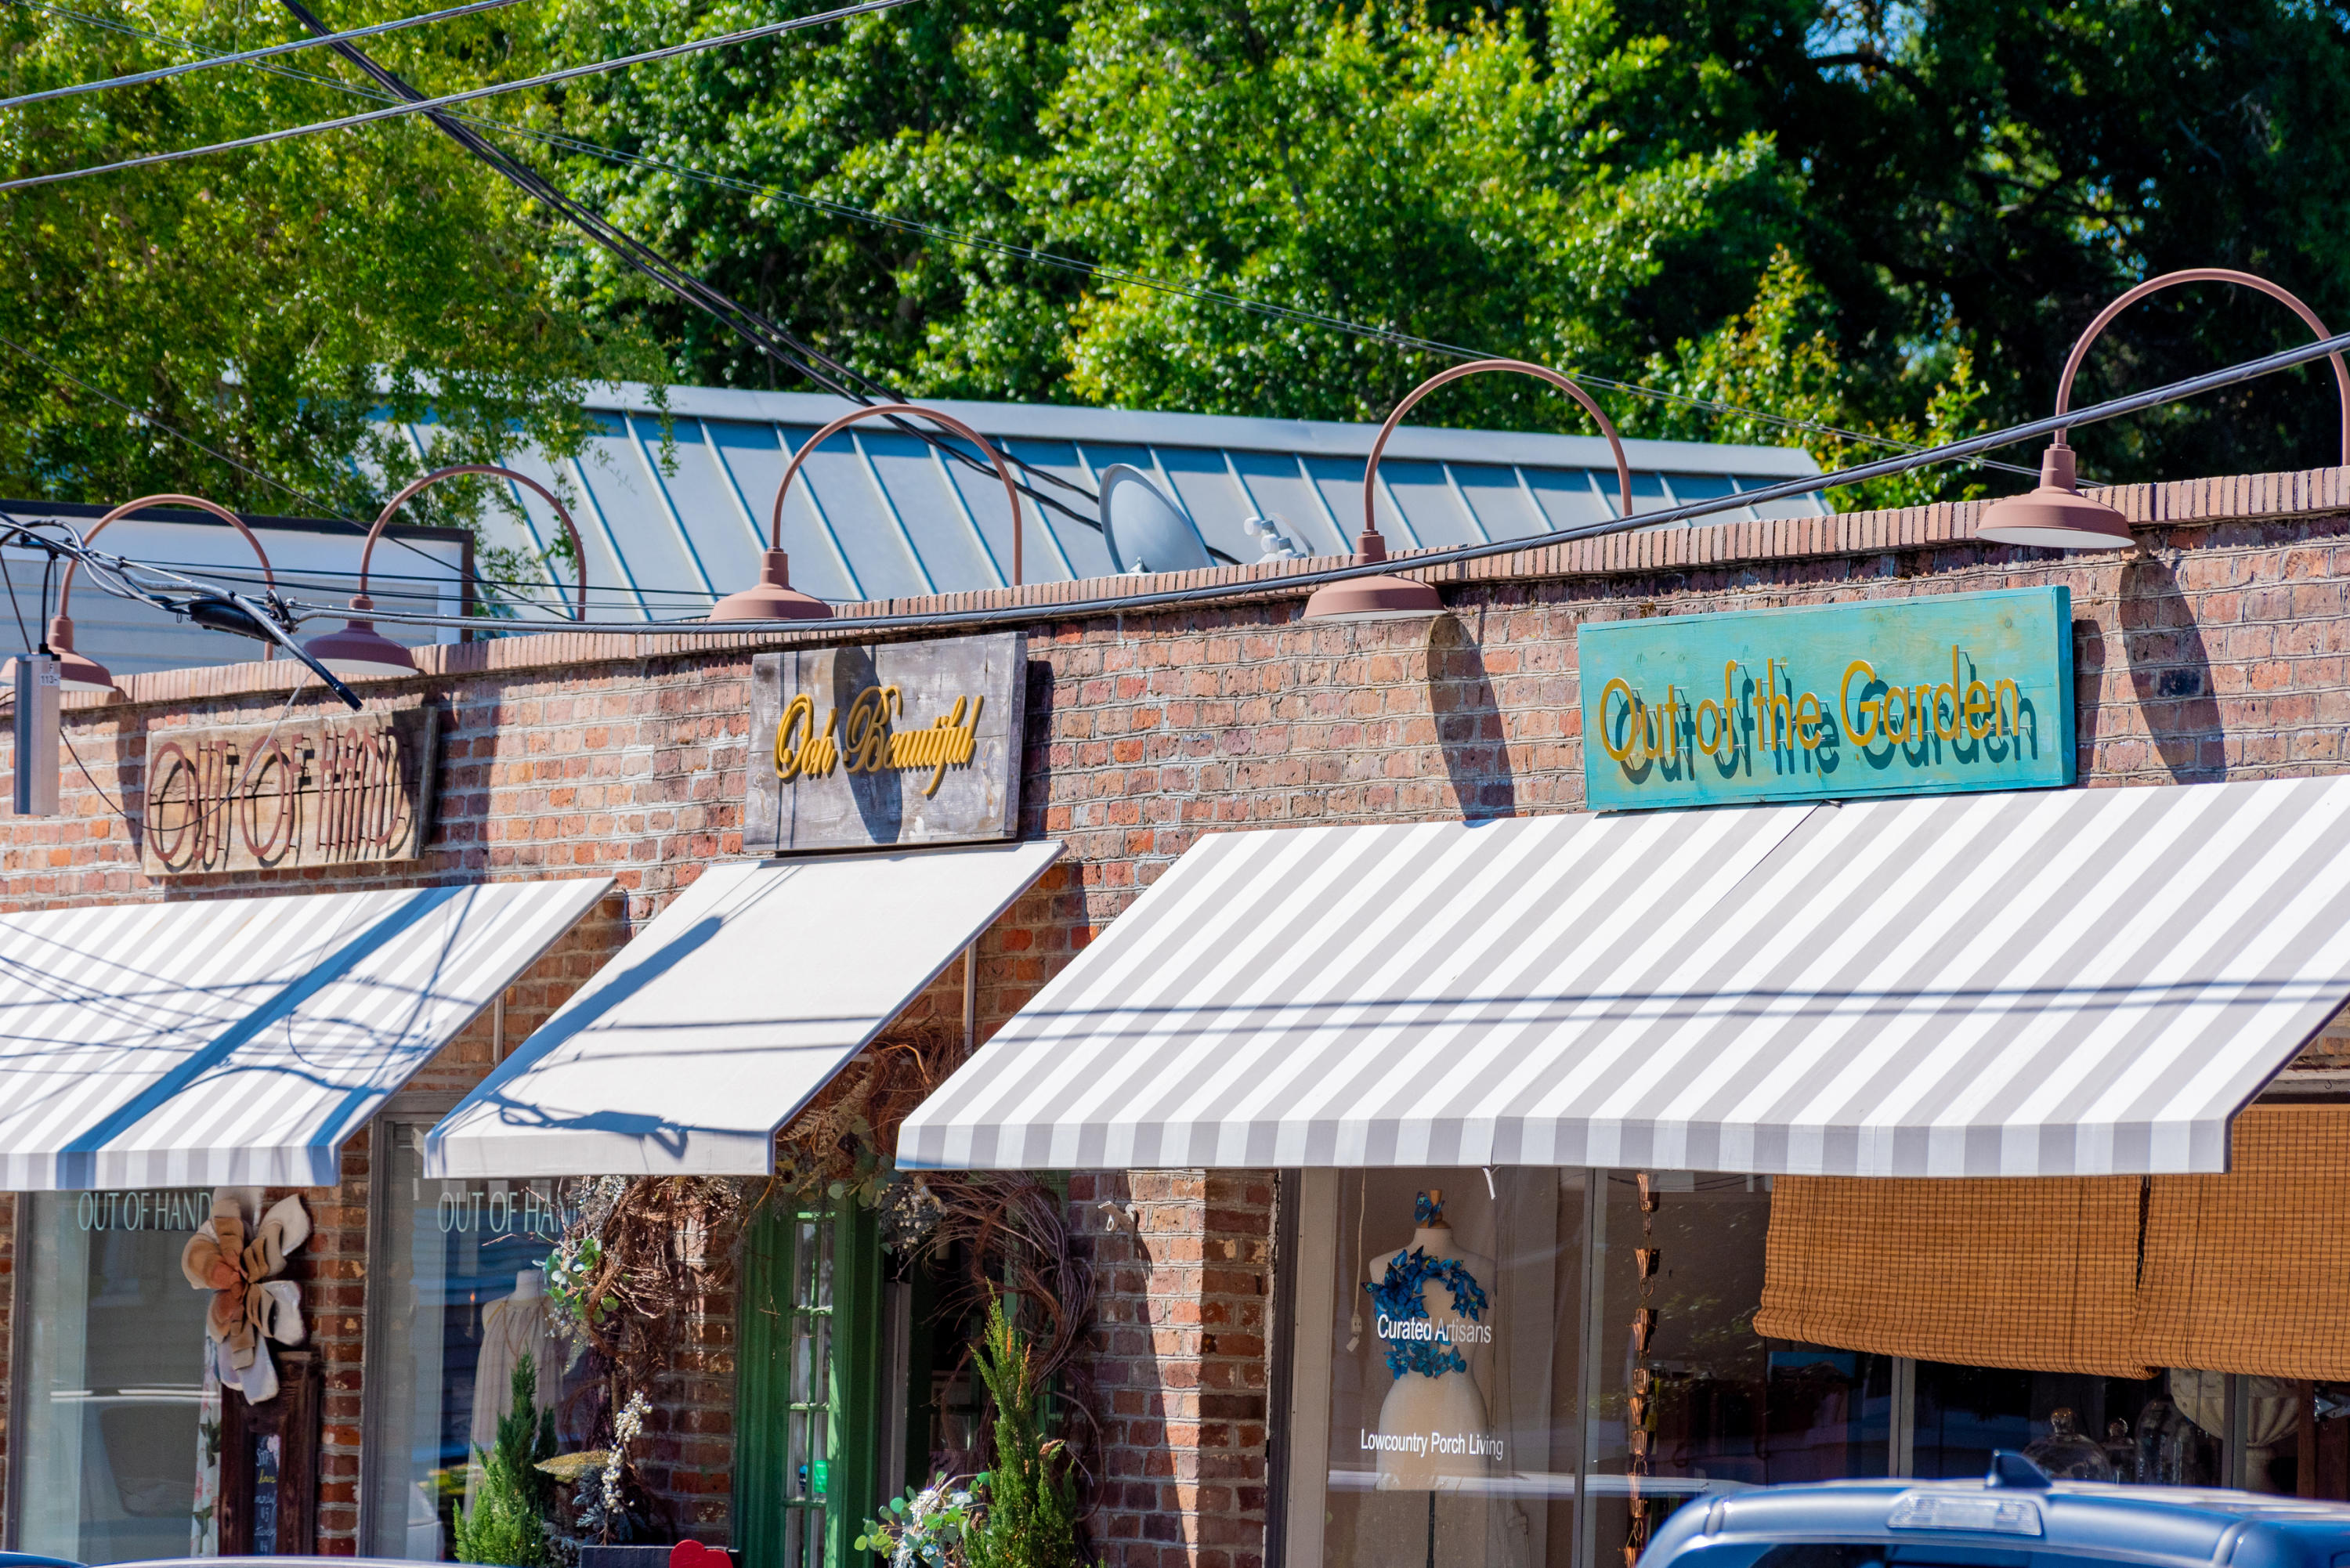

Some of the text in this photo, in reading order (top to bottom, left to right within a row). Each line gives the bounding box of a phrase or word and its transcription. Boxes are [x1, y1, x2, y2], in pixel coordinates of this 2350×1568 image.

[1600, 644, 2021, 761] Out of the Garden
[776, 685, 984, 796] Ooh Beautiful
[146, 725, 406, 862] OUT OF HAND
[78, 1191, 213, 1231] OUT OF HAND
[437, 1191, 578, 1233] OUT OF HAN
[1377, 1313, 1492, 1344] Curated Artisans
[1361, 1428, 1504, 1461] Lowcountry Porch Living
